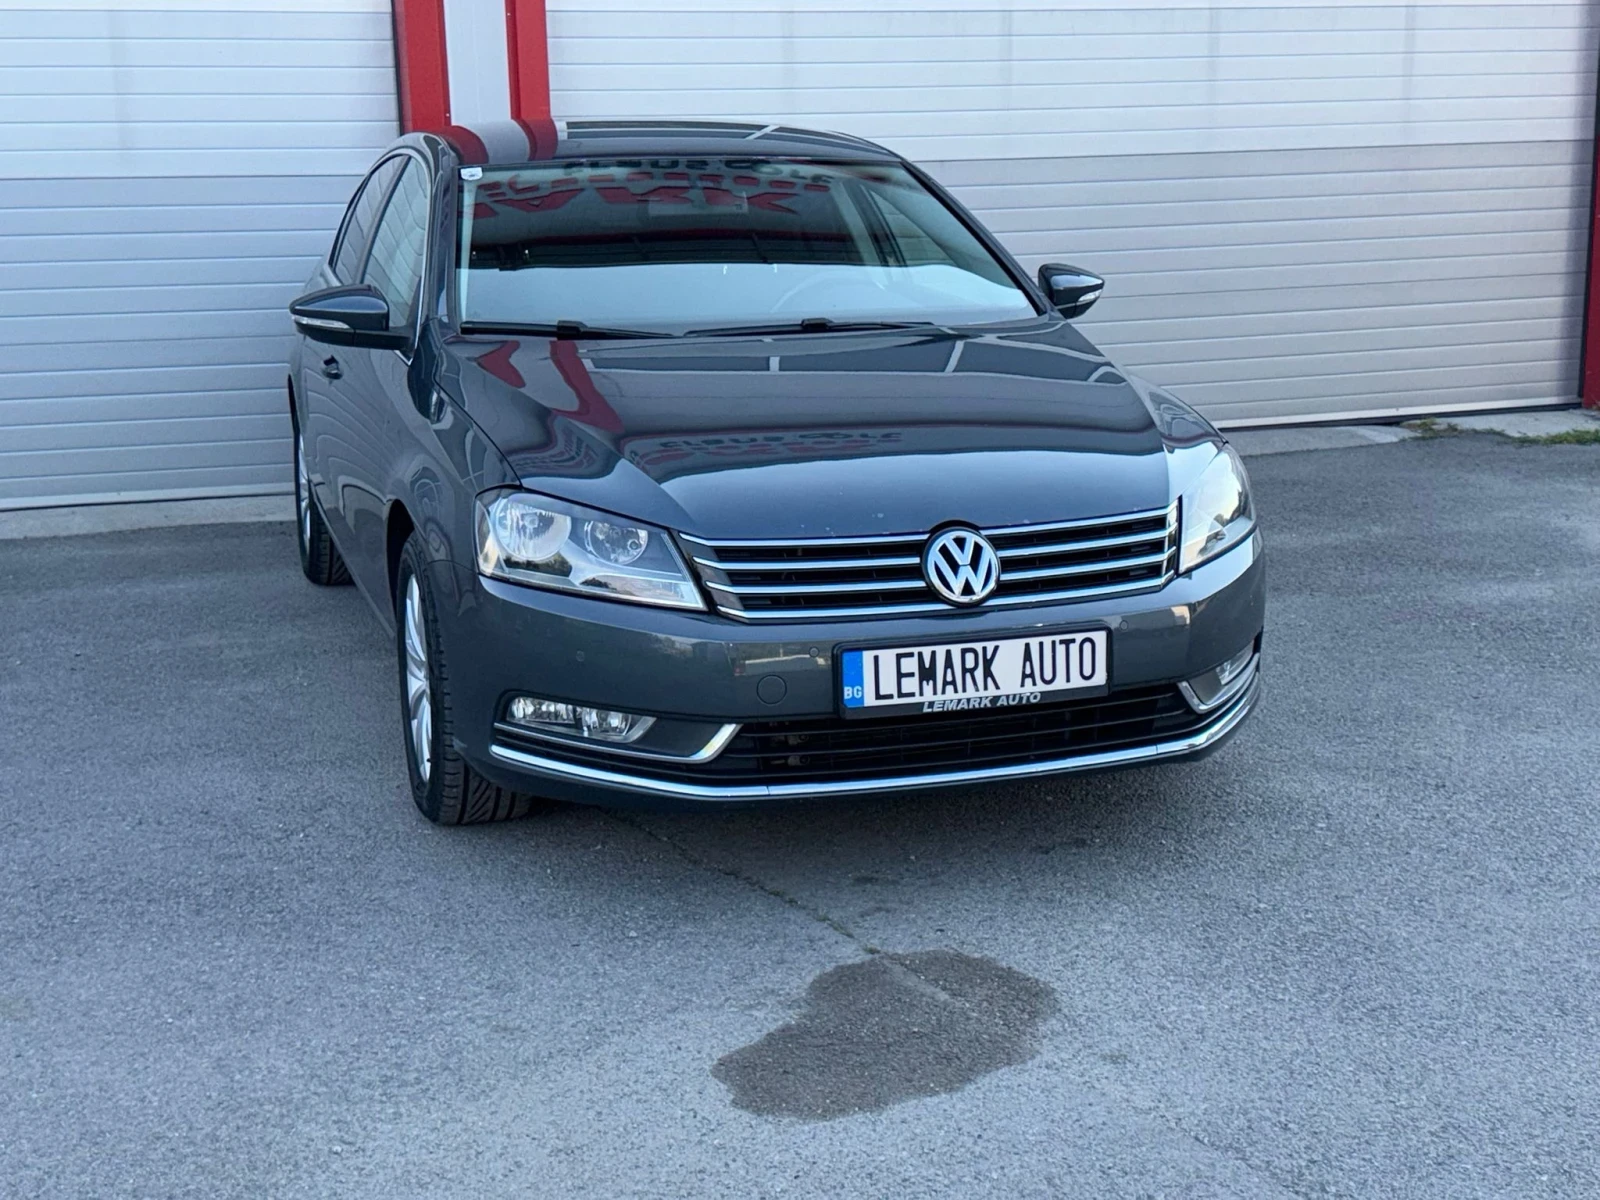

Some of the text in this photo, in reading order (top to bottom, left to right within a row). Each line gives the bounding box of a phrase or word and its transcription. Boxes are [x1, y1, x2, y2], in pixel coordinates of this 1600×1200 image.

[874, 637, 1096, 701] LEMARK AUTO
[844, 686, 862, 699] BG
[922, 692, 1041, 713] LEMARK AUTO
